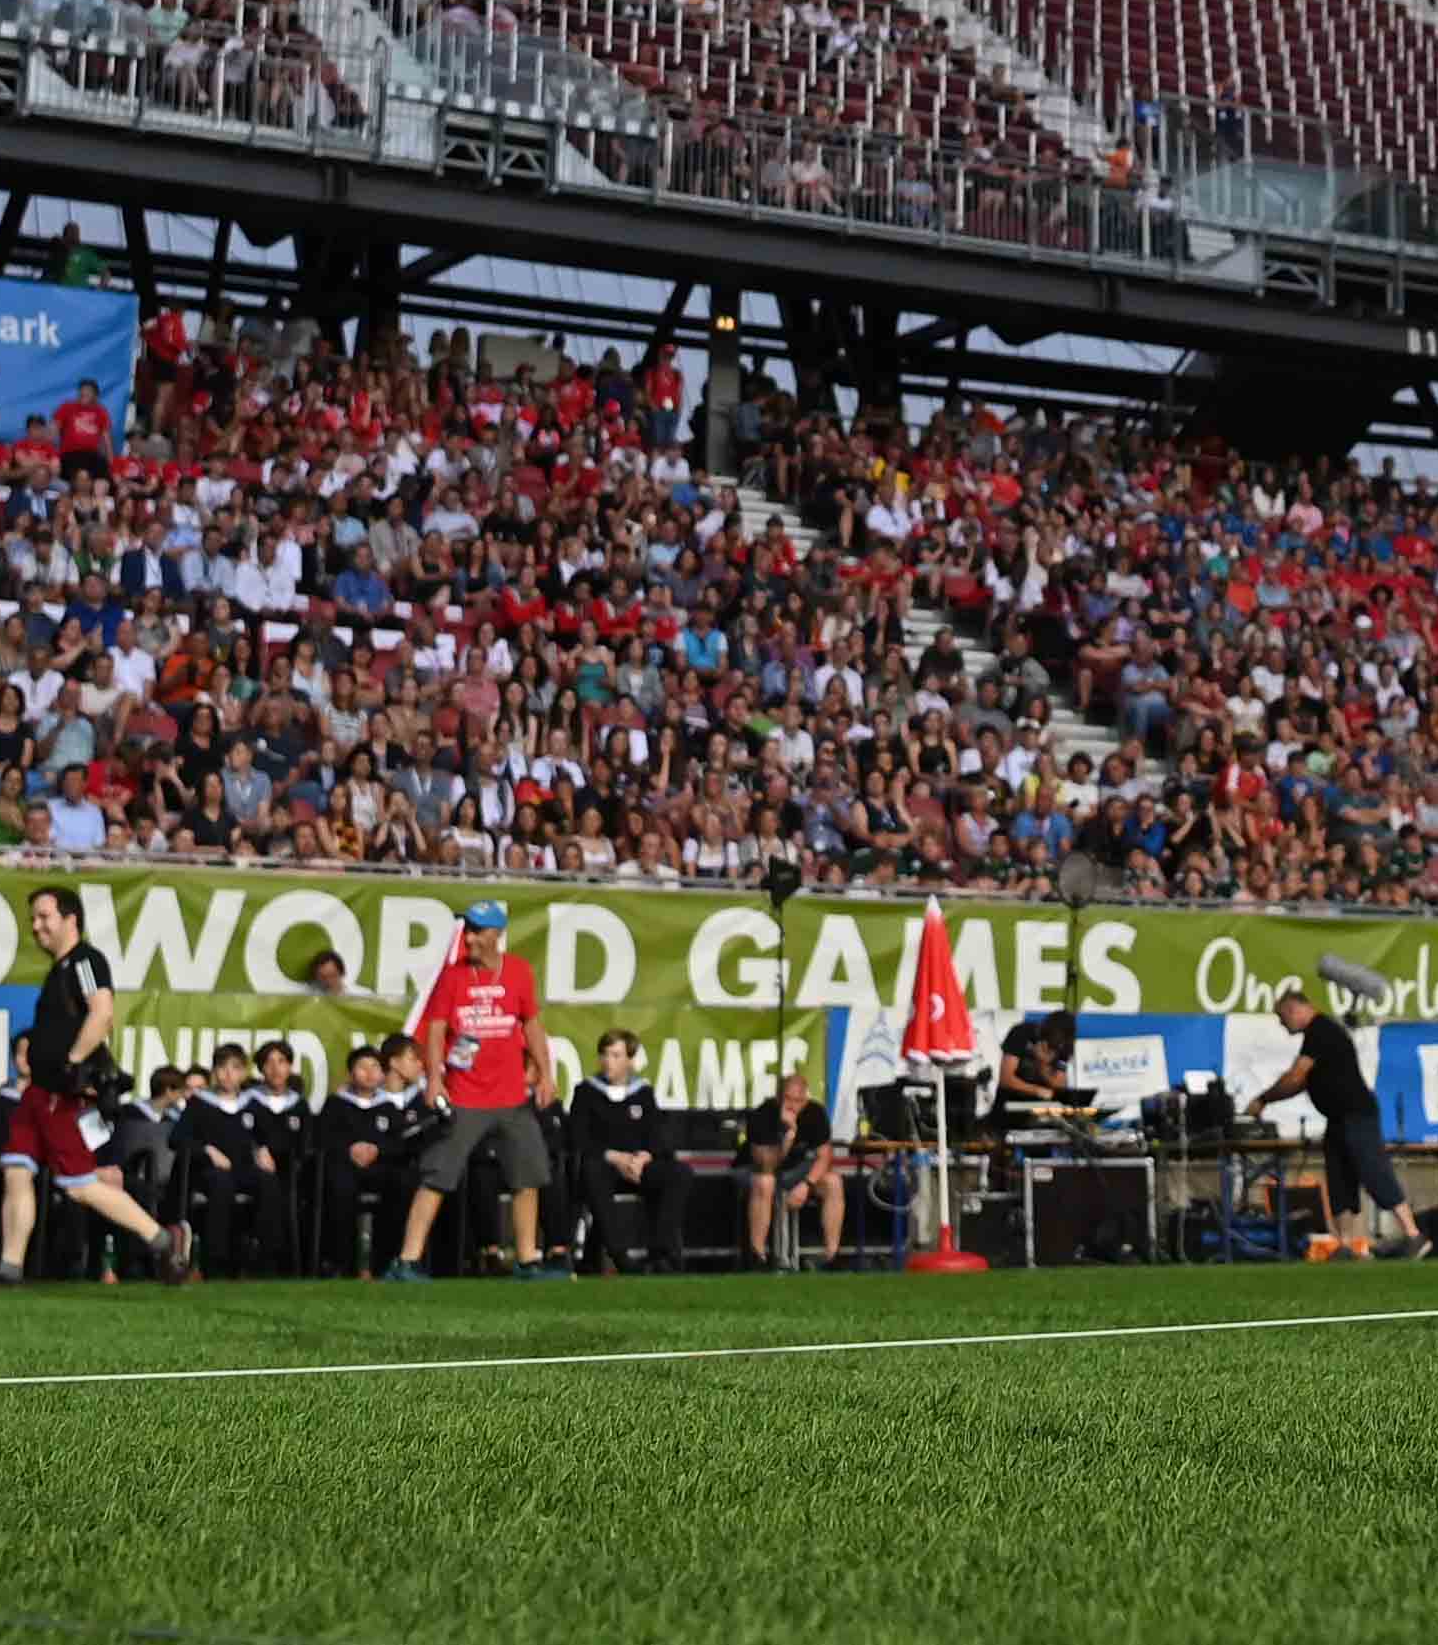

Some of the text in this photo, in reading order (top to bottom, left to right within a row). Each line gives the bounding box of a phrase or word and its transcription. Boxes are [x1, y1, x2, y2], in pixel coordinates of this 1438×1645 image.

[78, 882, 637, 1005] WORD
[689, 906, 1141, 1014] GAMES
[1196, 937, 1302, 1014] One
